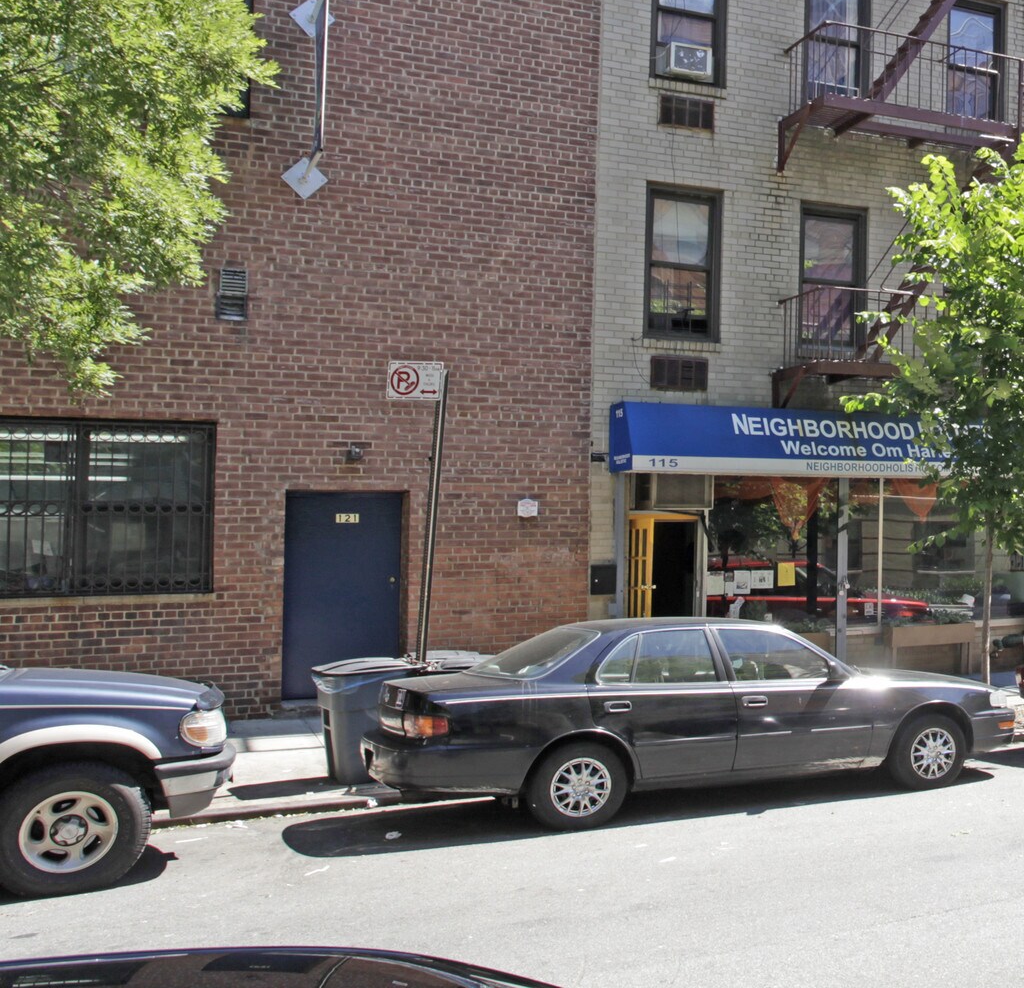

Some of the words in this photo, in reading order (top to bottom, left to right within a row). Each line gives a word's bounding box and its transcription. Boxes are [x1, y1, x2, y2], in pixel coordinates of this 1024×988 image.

[731, 413, 915, 440] NEIGHBORHOOD
[780, 440, 867, 457] Welcome
[871, 443, 904, 458] Om
[649, 458, 679, 468] 115
[338, 514, 357, 522] 121
